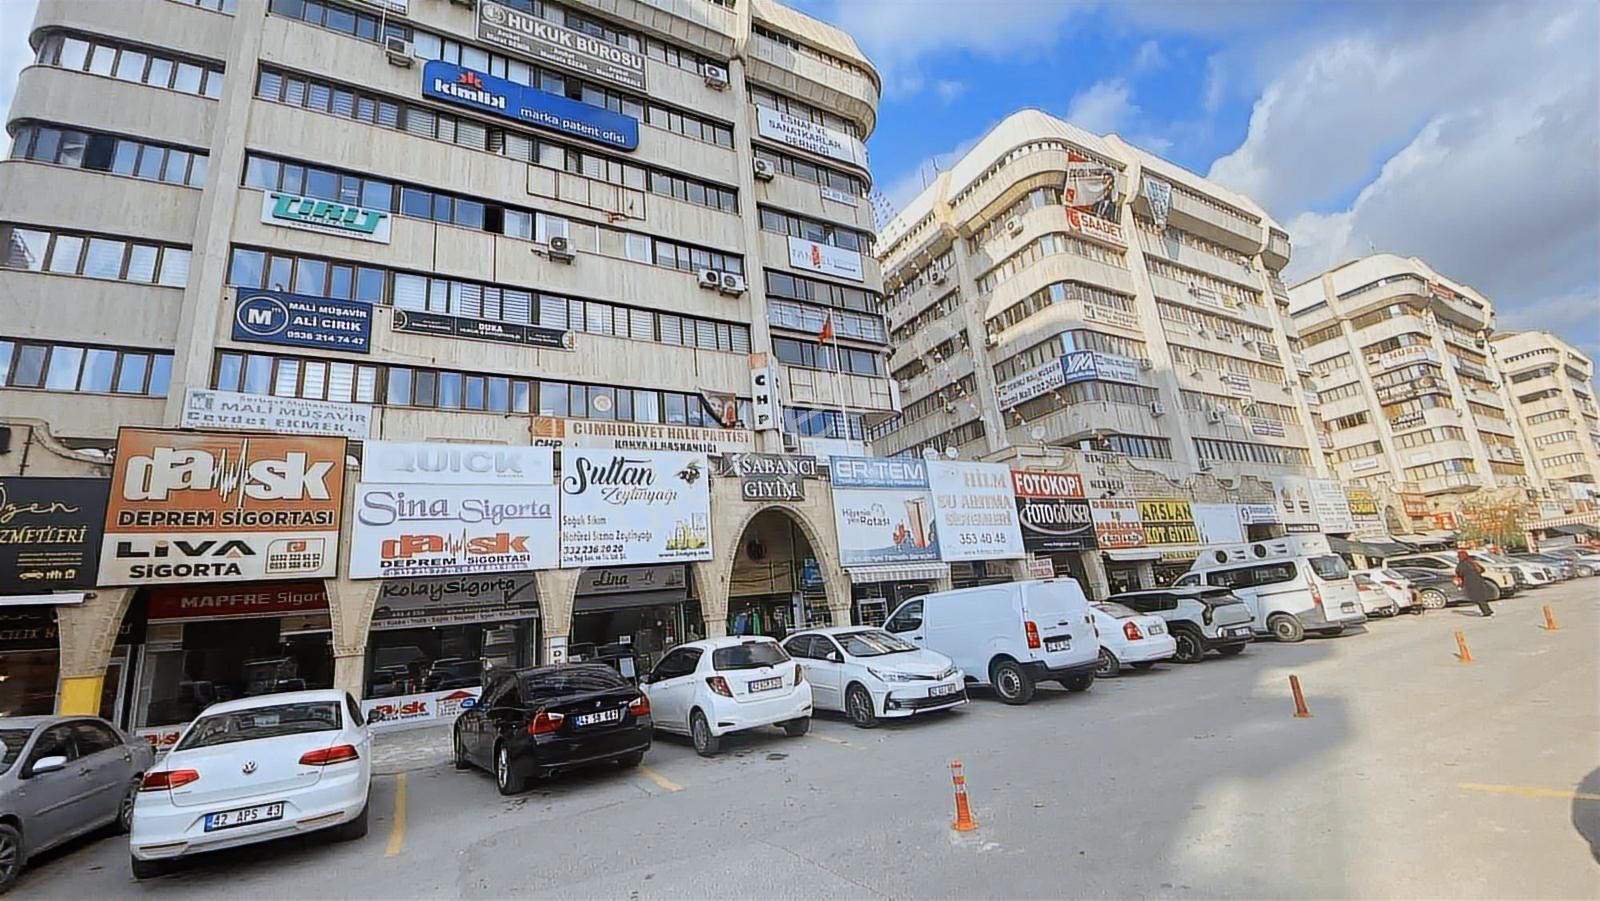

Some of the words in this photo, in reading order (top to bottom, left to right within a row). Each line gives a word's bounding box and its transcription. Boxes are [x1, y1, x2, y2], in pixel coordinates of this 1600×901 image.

[507, 12, 574, 47] HUKUK
[576, 37, 643, 70] BÜROSU
[520, 107, 559, 125] marka
[562, 119, 601, 138] patent
[602, 129, 626, 144] ofisi
[248, 308, 272, 326] M
[289, 302, 316, 314] MALİ
[319, 306, 368, 319] MÜŞAVİR
[293, 316, 318, 327] ALİ
[322, 319, 361, 332] CIRIK
[315, 333, 334, 343] 214
[337, 335, 350, 344] 74
[351, 337, 365, 346] 47
[221, 402, 273, 415] MALİ
[279, 407, 367, 424] MÜŞAVİR
[563, 456, 656, 495] Sultan
[742, 459, 816, 475] SABANCI
[744, 480, 797, 498] GİYİM
[1014, 472, 1082, 496] FOTOKOPİ
[117, 510, 218, 527] DEPREM
[221, 508, 334, 527] SİGORTASI
[358, 491, 449, 526] Sina
[458, 498, 552, 526] Sigorta
[1142, 503, 1192, 521] ARSLAN
[960, 532, 977, 545] 353
[129, 562, 243, 579] SİGORTA
[380, 557, 457, 568] DEPREM
[592, 570, 629, 586] Lina
[180, 593, 271, 609] MAPFRE
[277, 591, 328, 605] Sigort
[213, 813, 227, 826] 42
[236, 809, 258, 823] APS
[266, 804, 280, 816] 43
